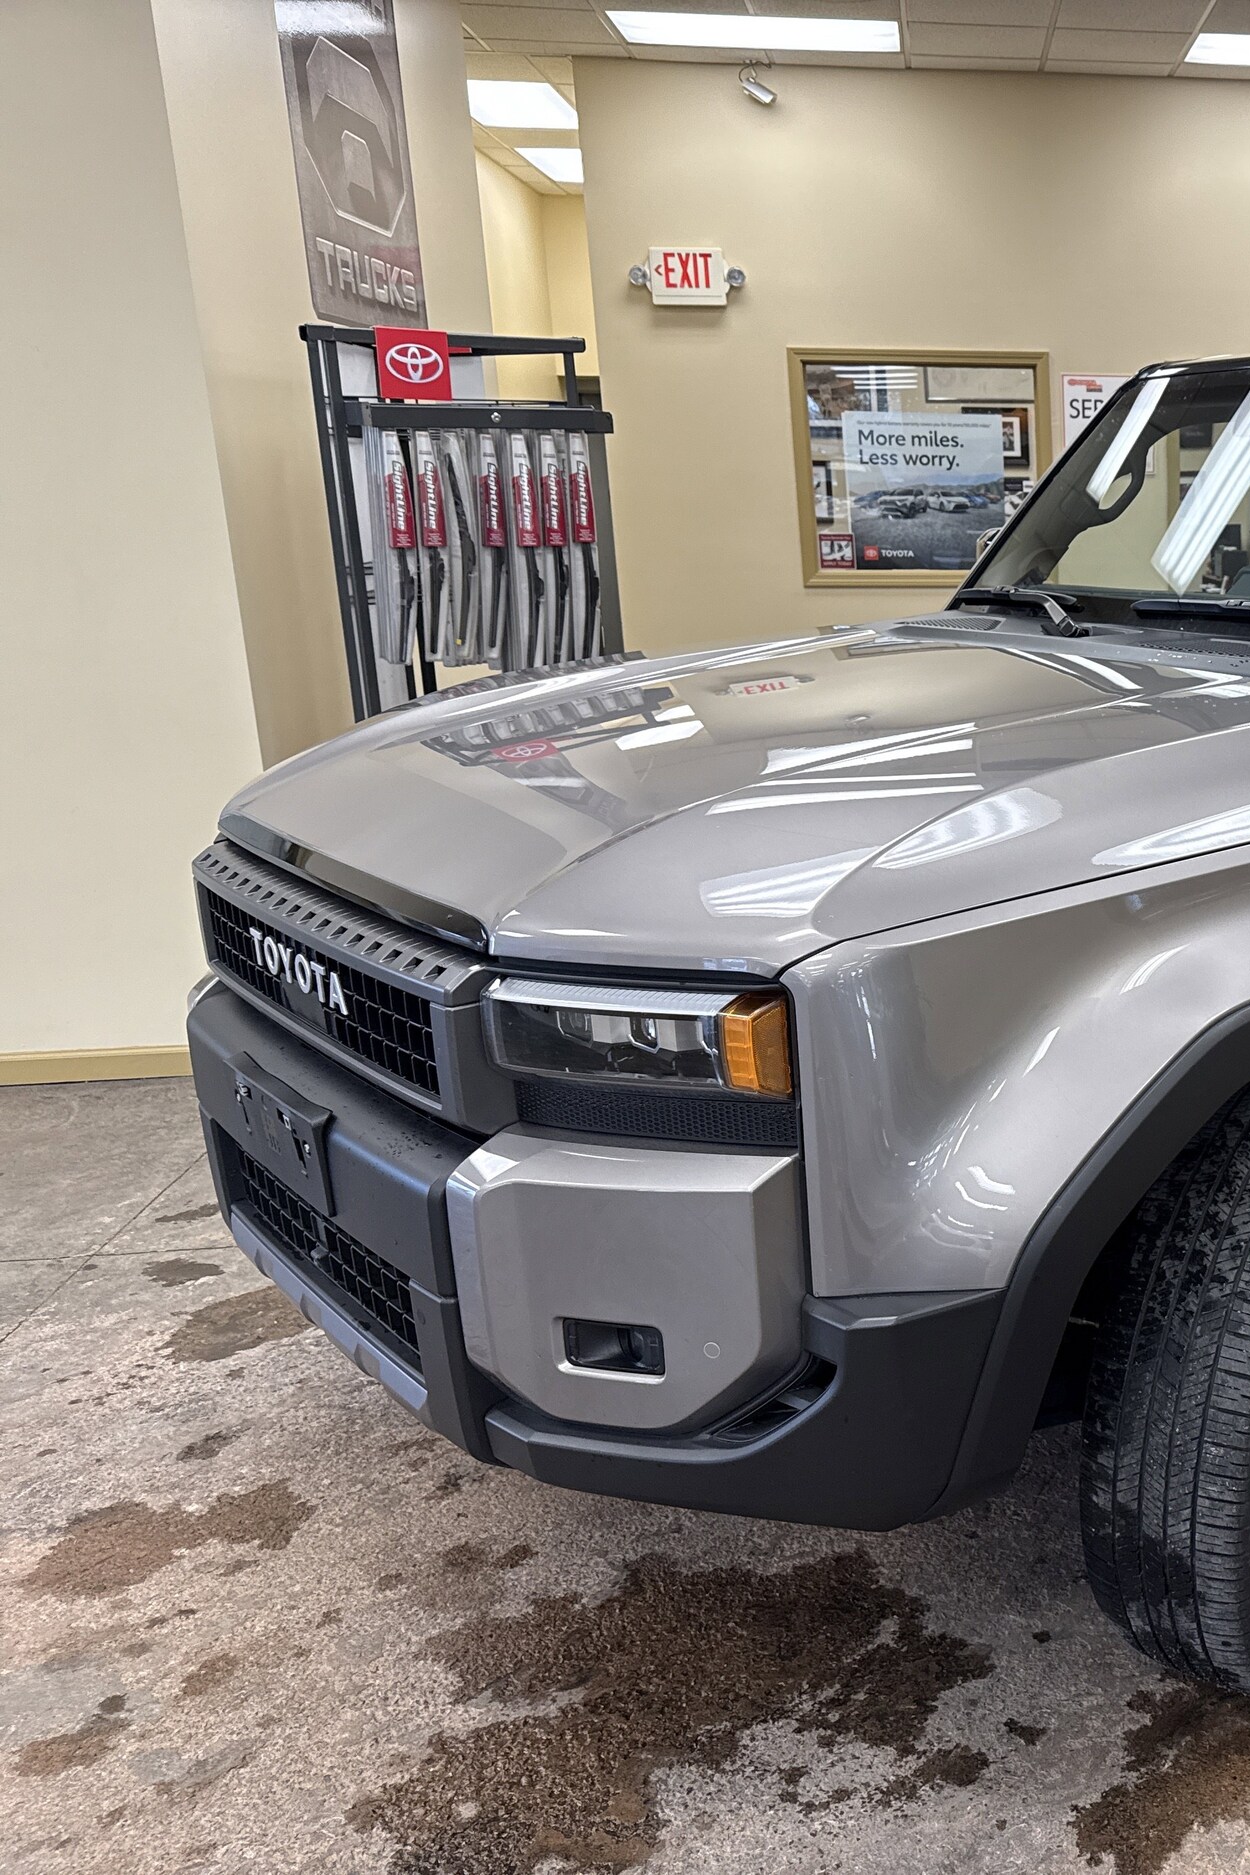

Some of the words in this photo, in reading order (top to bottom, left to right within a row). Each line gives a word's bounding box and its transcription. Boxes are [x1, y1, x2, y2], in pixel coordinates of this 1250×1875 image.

[316, 237, 417, 312] TRUCKS
[663, 252, 712, 288] EXIT
[858, 429, 906, 446] More
[911, 431, 964, 448] miles.
[859, 449, 898, 465] Less
[903, 453, 960, 471] worry.
[392, 460, 406, 531] SightLine
[423, 460, 437, 530] SightLine
[487, 462, 499, 530] SightLine
[519, 462, 532, 531] SightLine
[547, 463, 559, 530] SightLine
[576, 460, 588, 527] SightLine
[249, 926, 349, 1016] TOYOTA
